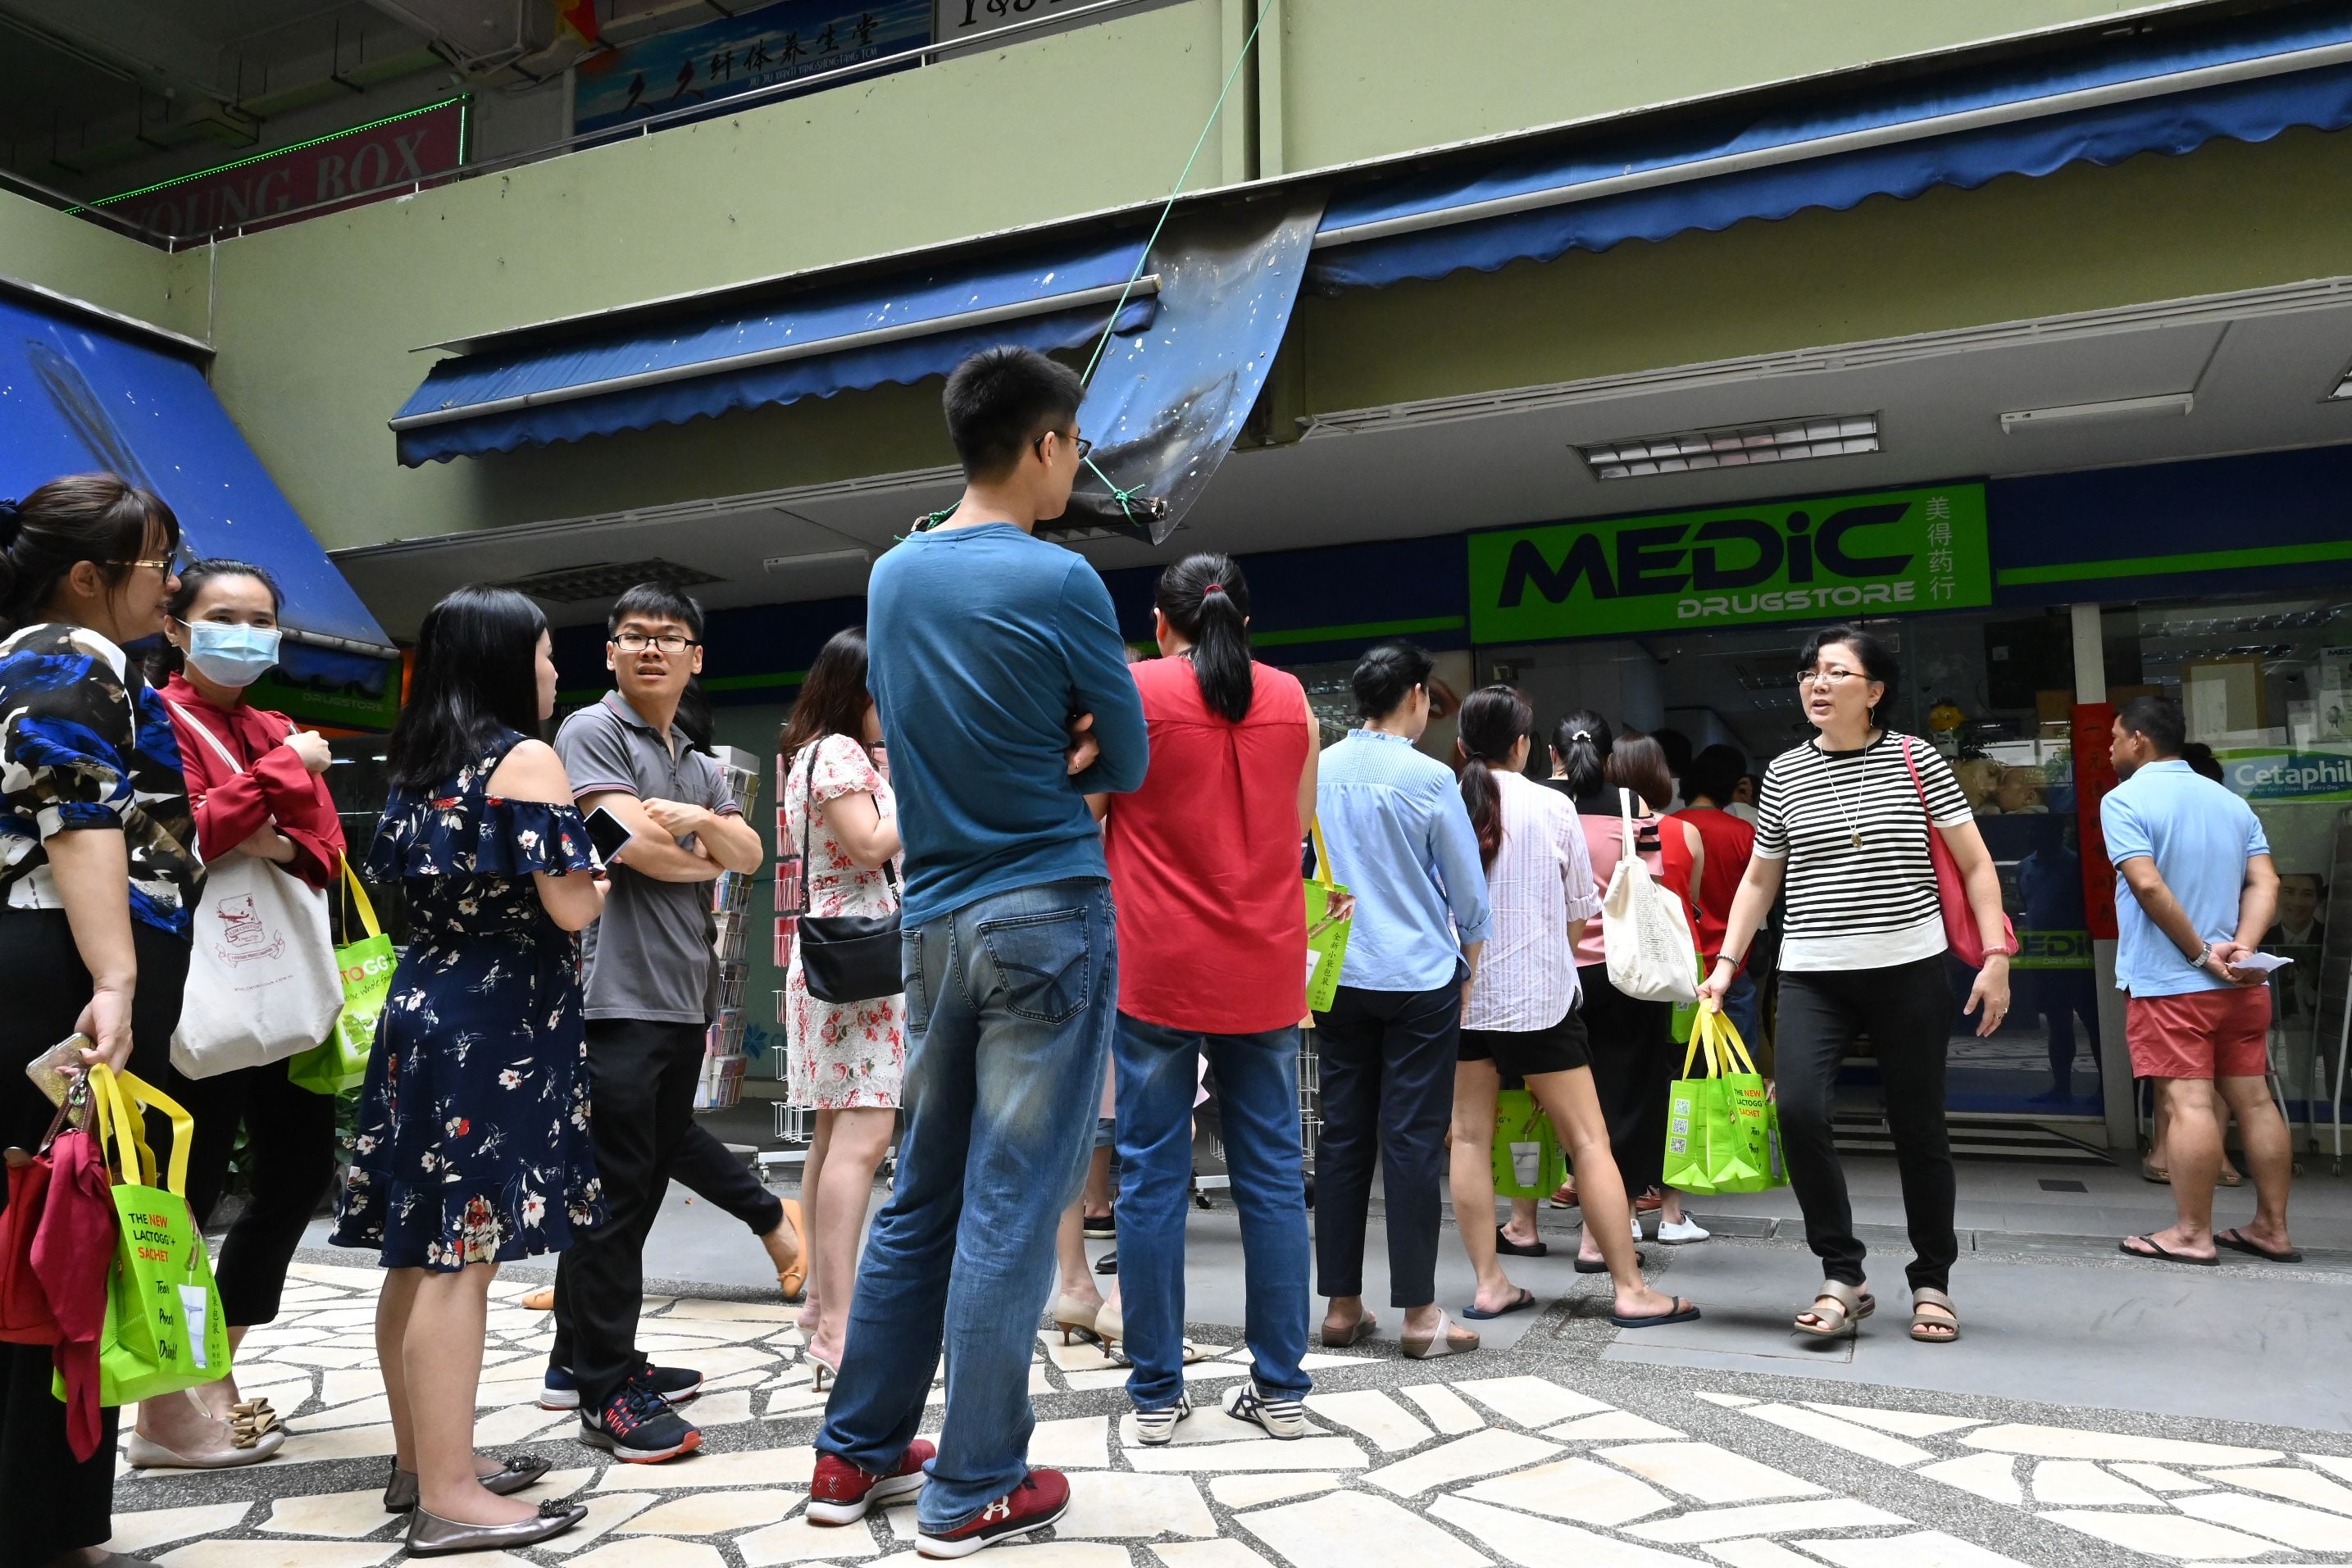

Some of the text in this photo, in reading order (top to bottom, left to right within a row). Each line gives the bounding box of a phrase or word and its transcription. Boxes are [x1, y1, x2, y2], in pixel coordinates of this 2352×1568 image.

[621, 12, 879, 115] 久久纤体养生堂
[862, 47, 878, 60] TCM
[316, 130, 427, 202] BOX
[1925, 496, 1956, 602] 美得药行
[1677, 580, 1915, 619] DRUGSTORE
[302, 692, 384, 712] DRUGSTORE
[2235, 760, 2352, 790] Cetaphil
[1744, 1089, 1761, 1098] NEW
[128, 1213, 168, 1229] THE NEW
[138, 1246, 169, 1263] SACHET
[156, 1280, 170, 1294] Tear
